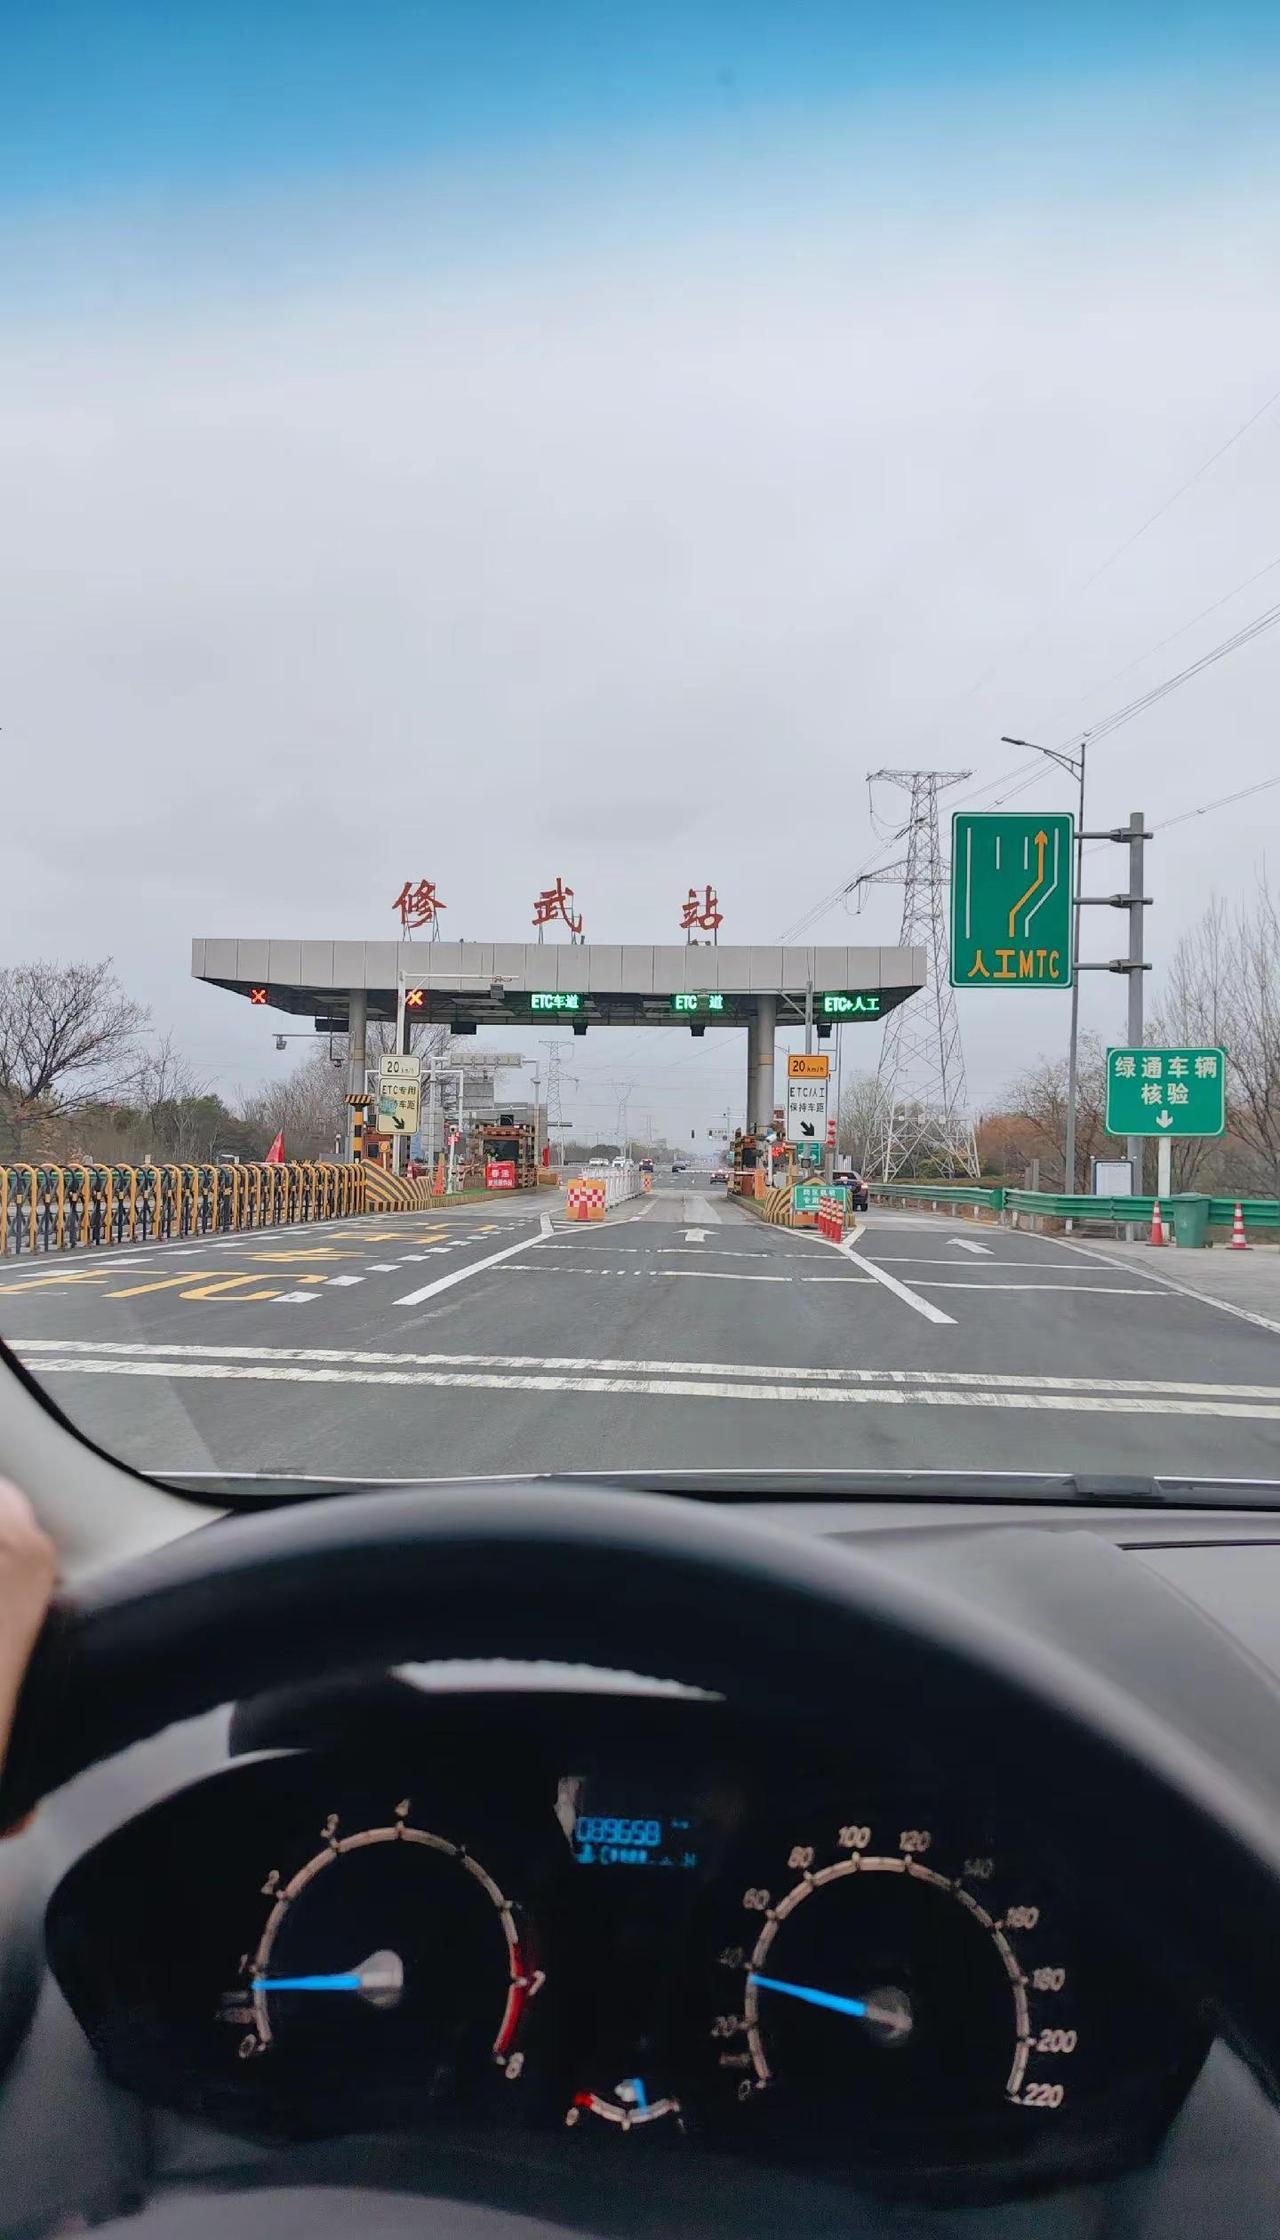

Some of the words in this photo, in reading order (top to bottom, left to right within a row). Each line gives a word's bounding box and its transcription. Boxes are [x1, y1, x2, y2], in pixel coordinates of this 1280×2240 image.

[968, 950, 1060, 978] 人工MTC
[531, 994, 579, 1008] ETC车道
[675, 995, 724, 1009] ETC道
[387, 1061, 399, 1073] 20
[792, 1060, 806, 1072] 20
[1115, 1056, 1217, 1079] 绿通车辆
[382, 1085, 416, 1095] ETC专用
[790, 1087, 825, 1097] ETC/人工
[1141, 1083, 1189, 1105] 核验
[790, 1103, 824, 1112] 保持车距
[0, 1269, 329, 1301] ETC
[838, 1825, 871, 1849] 100
[899, 1830, 932, 1852] 120
[787, 1846, 815, 1869] 80
[742, 1887, 770, 1911] 60
[1036, 2029, 1078, 2053] 200
[1024, 2082, 1065, 2108] 220
